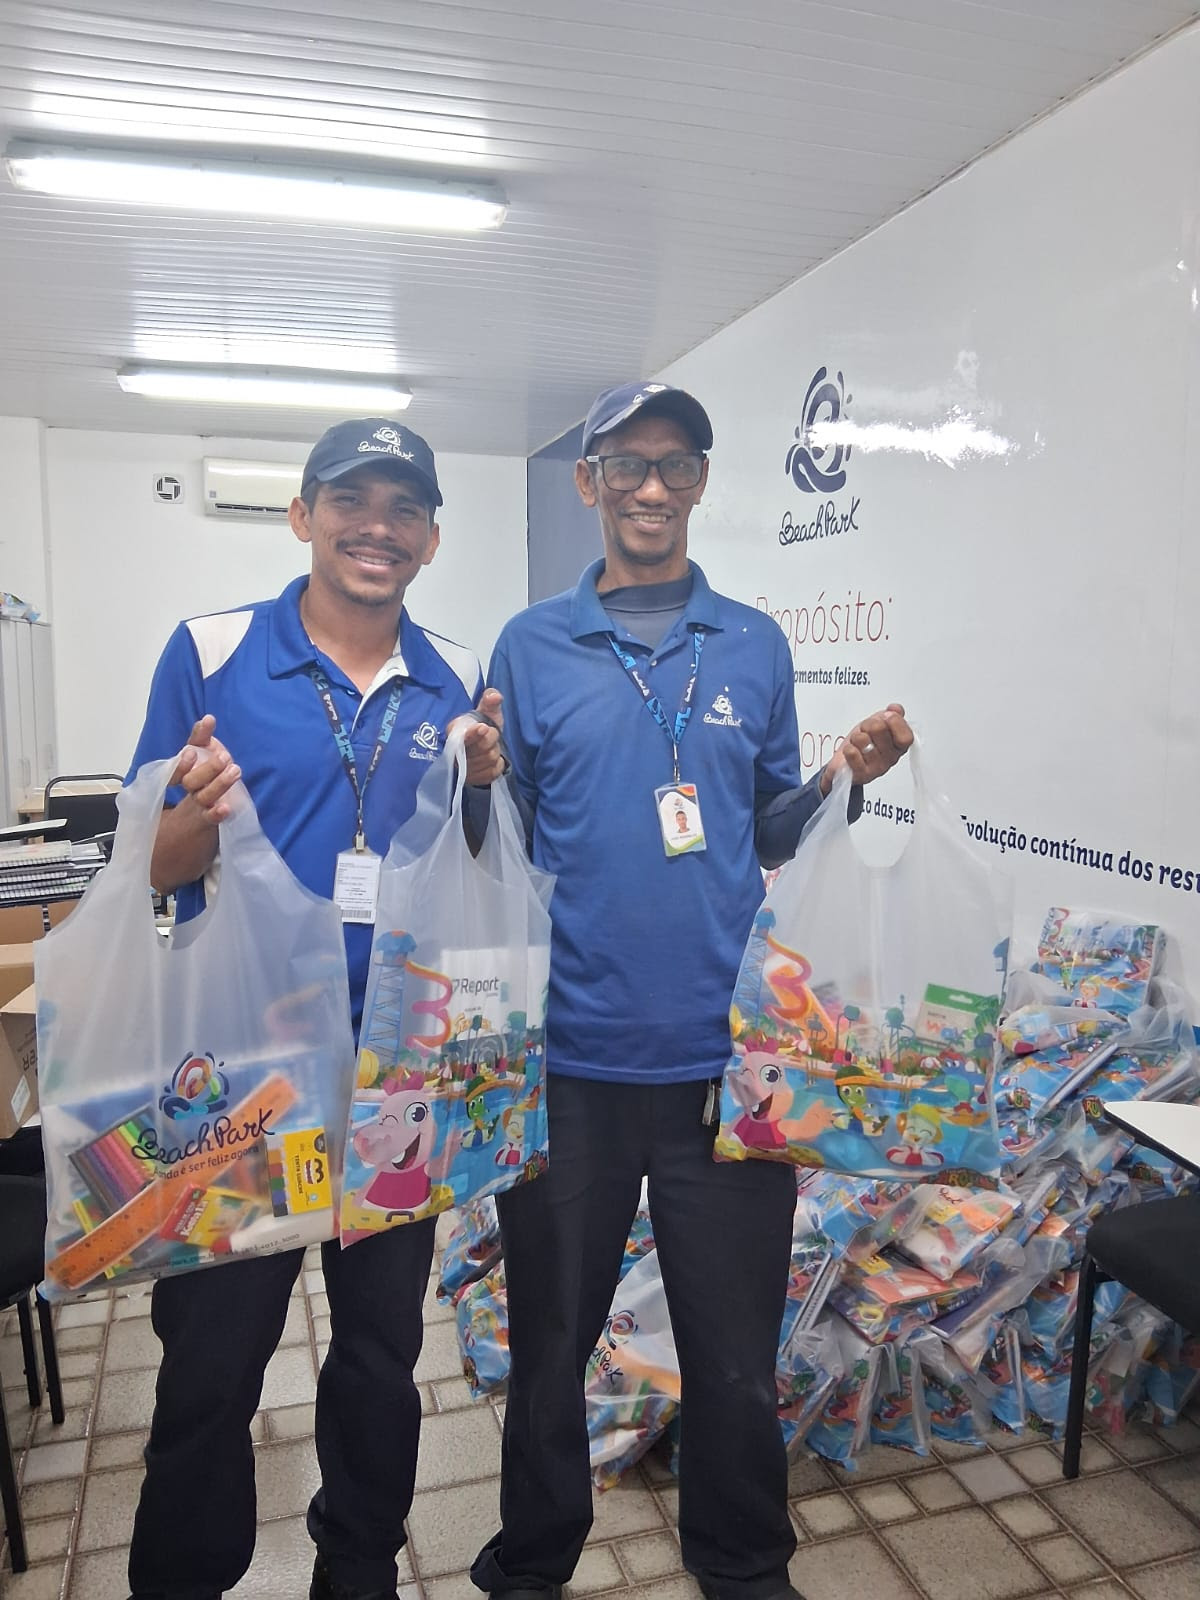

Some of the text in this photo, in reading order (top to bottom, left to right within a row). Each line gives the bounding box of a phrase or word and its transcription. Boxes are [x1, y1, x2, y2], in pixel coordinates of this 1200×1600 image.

[794, 666, 871, 686] omentos felizes.
[874, 798, 893, 819] das
[960, 815, 1027, 853] volução
[1031, 838, 1114, 872] contínua
[1118, 851, 1154, 882] dos
[461, 977, 500, 996] Report
[188, 1161, 205, 1172] ser
[207, 1153, 230, 1167] feliz
[231, 1145, 259, 1162] agora
